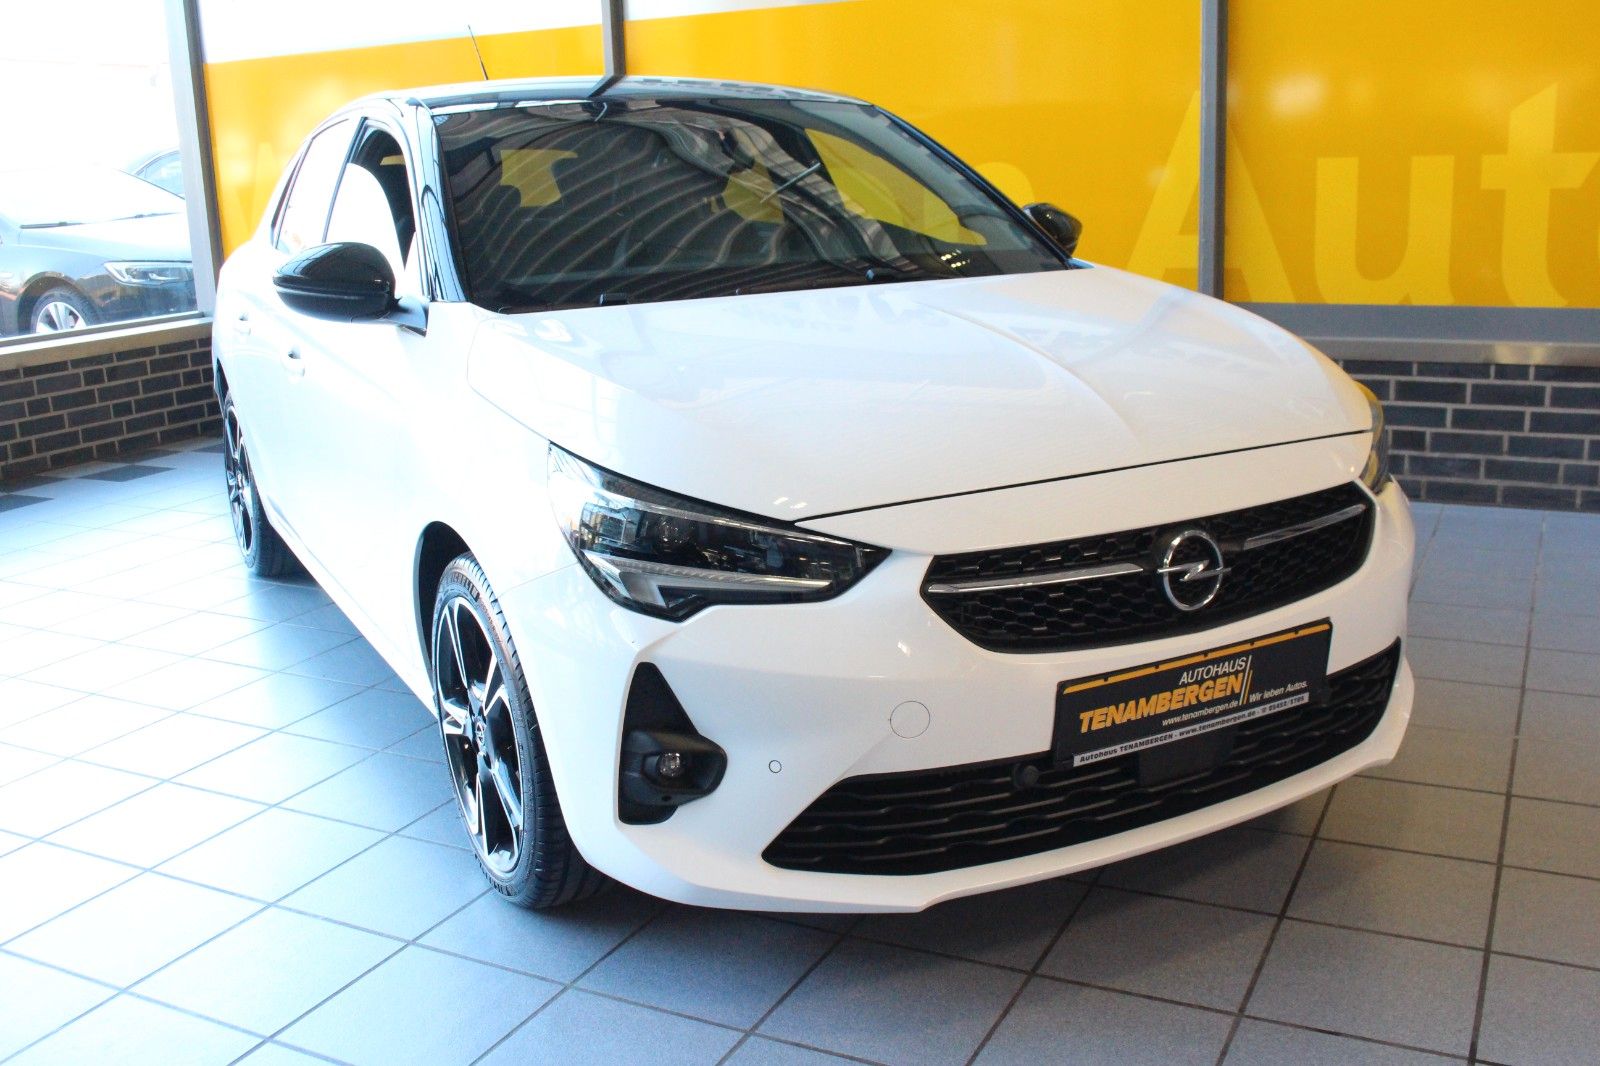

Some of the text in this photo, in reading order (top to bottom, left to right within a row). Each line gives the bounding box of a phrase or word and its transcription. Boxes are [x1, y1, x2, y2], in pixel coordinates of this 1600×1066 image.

[1126, 83, 1600, 308] Aut
[1179, 657, 1246, 685] AUTOHAUS
[1079, 673, 1243, 733] TENAMBERGEN
[1162, 700, 1239, 726] www.tenambergen.de
[1249, 692, 1262, 702] Wir
[1263, 686, 1285, 700] leben
[1079, 748, 1118, 762] Autohaus
[1120, 734, 1173, 753] TENAMBERGEN
[1179, 710, 1256, 736] www.tenambergen.de
